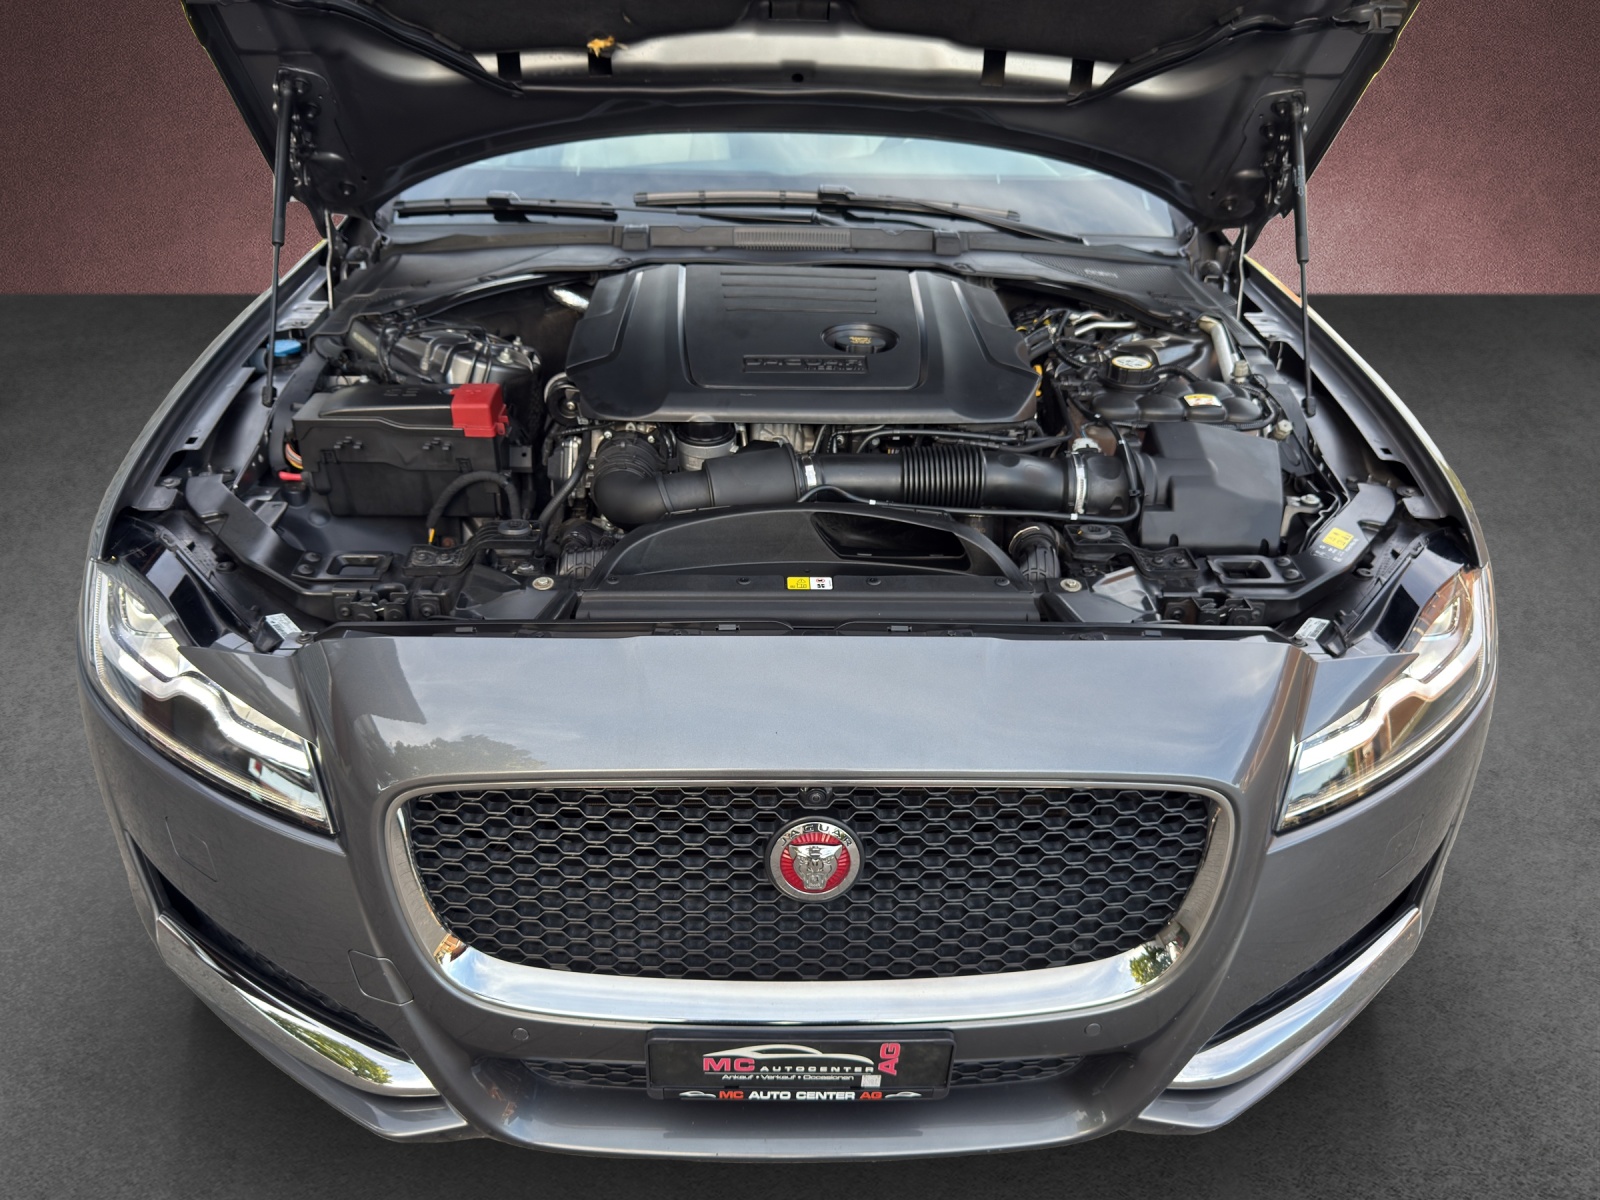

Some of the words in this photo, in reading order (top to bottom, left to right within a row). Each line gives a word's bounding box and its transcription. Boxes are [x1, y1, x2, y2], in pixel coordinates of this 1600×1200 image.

[781, 823, 852, 847] JAGUAR
[703, 1058, 755, 1072] MC
[878, 1042, 901, 1075] AG
[719, 1091, 744, 1099] MC
[748, 1091, 791, 1100] AUTO
[796, 1091, 855, 1100] CENTER
[860, 1091, 883, 1099] AG
